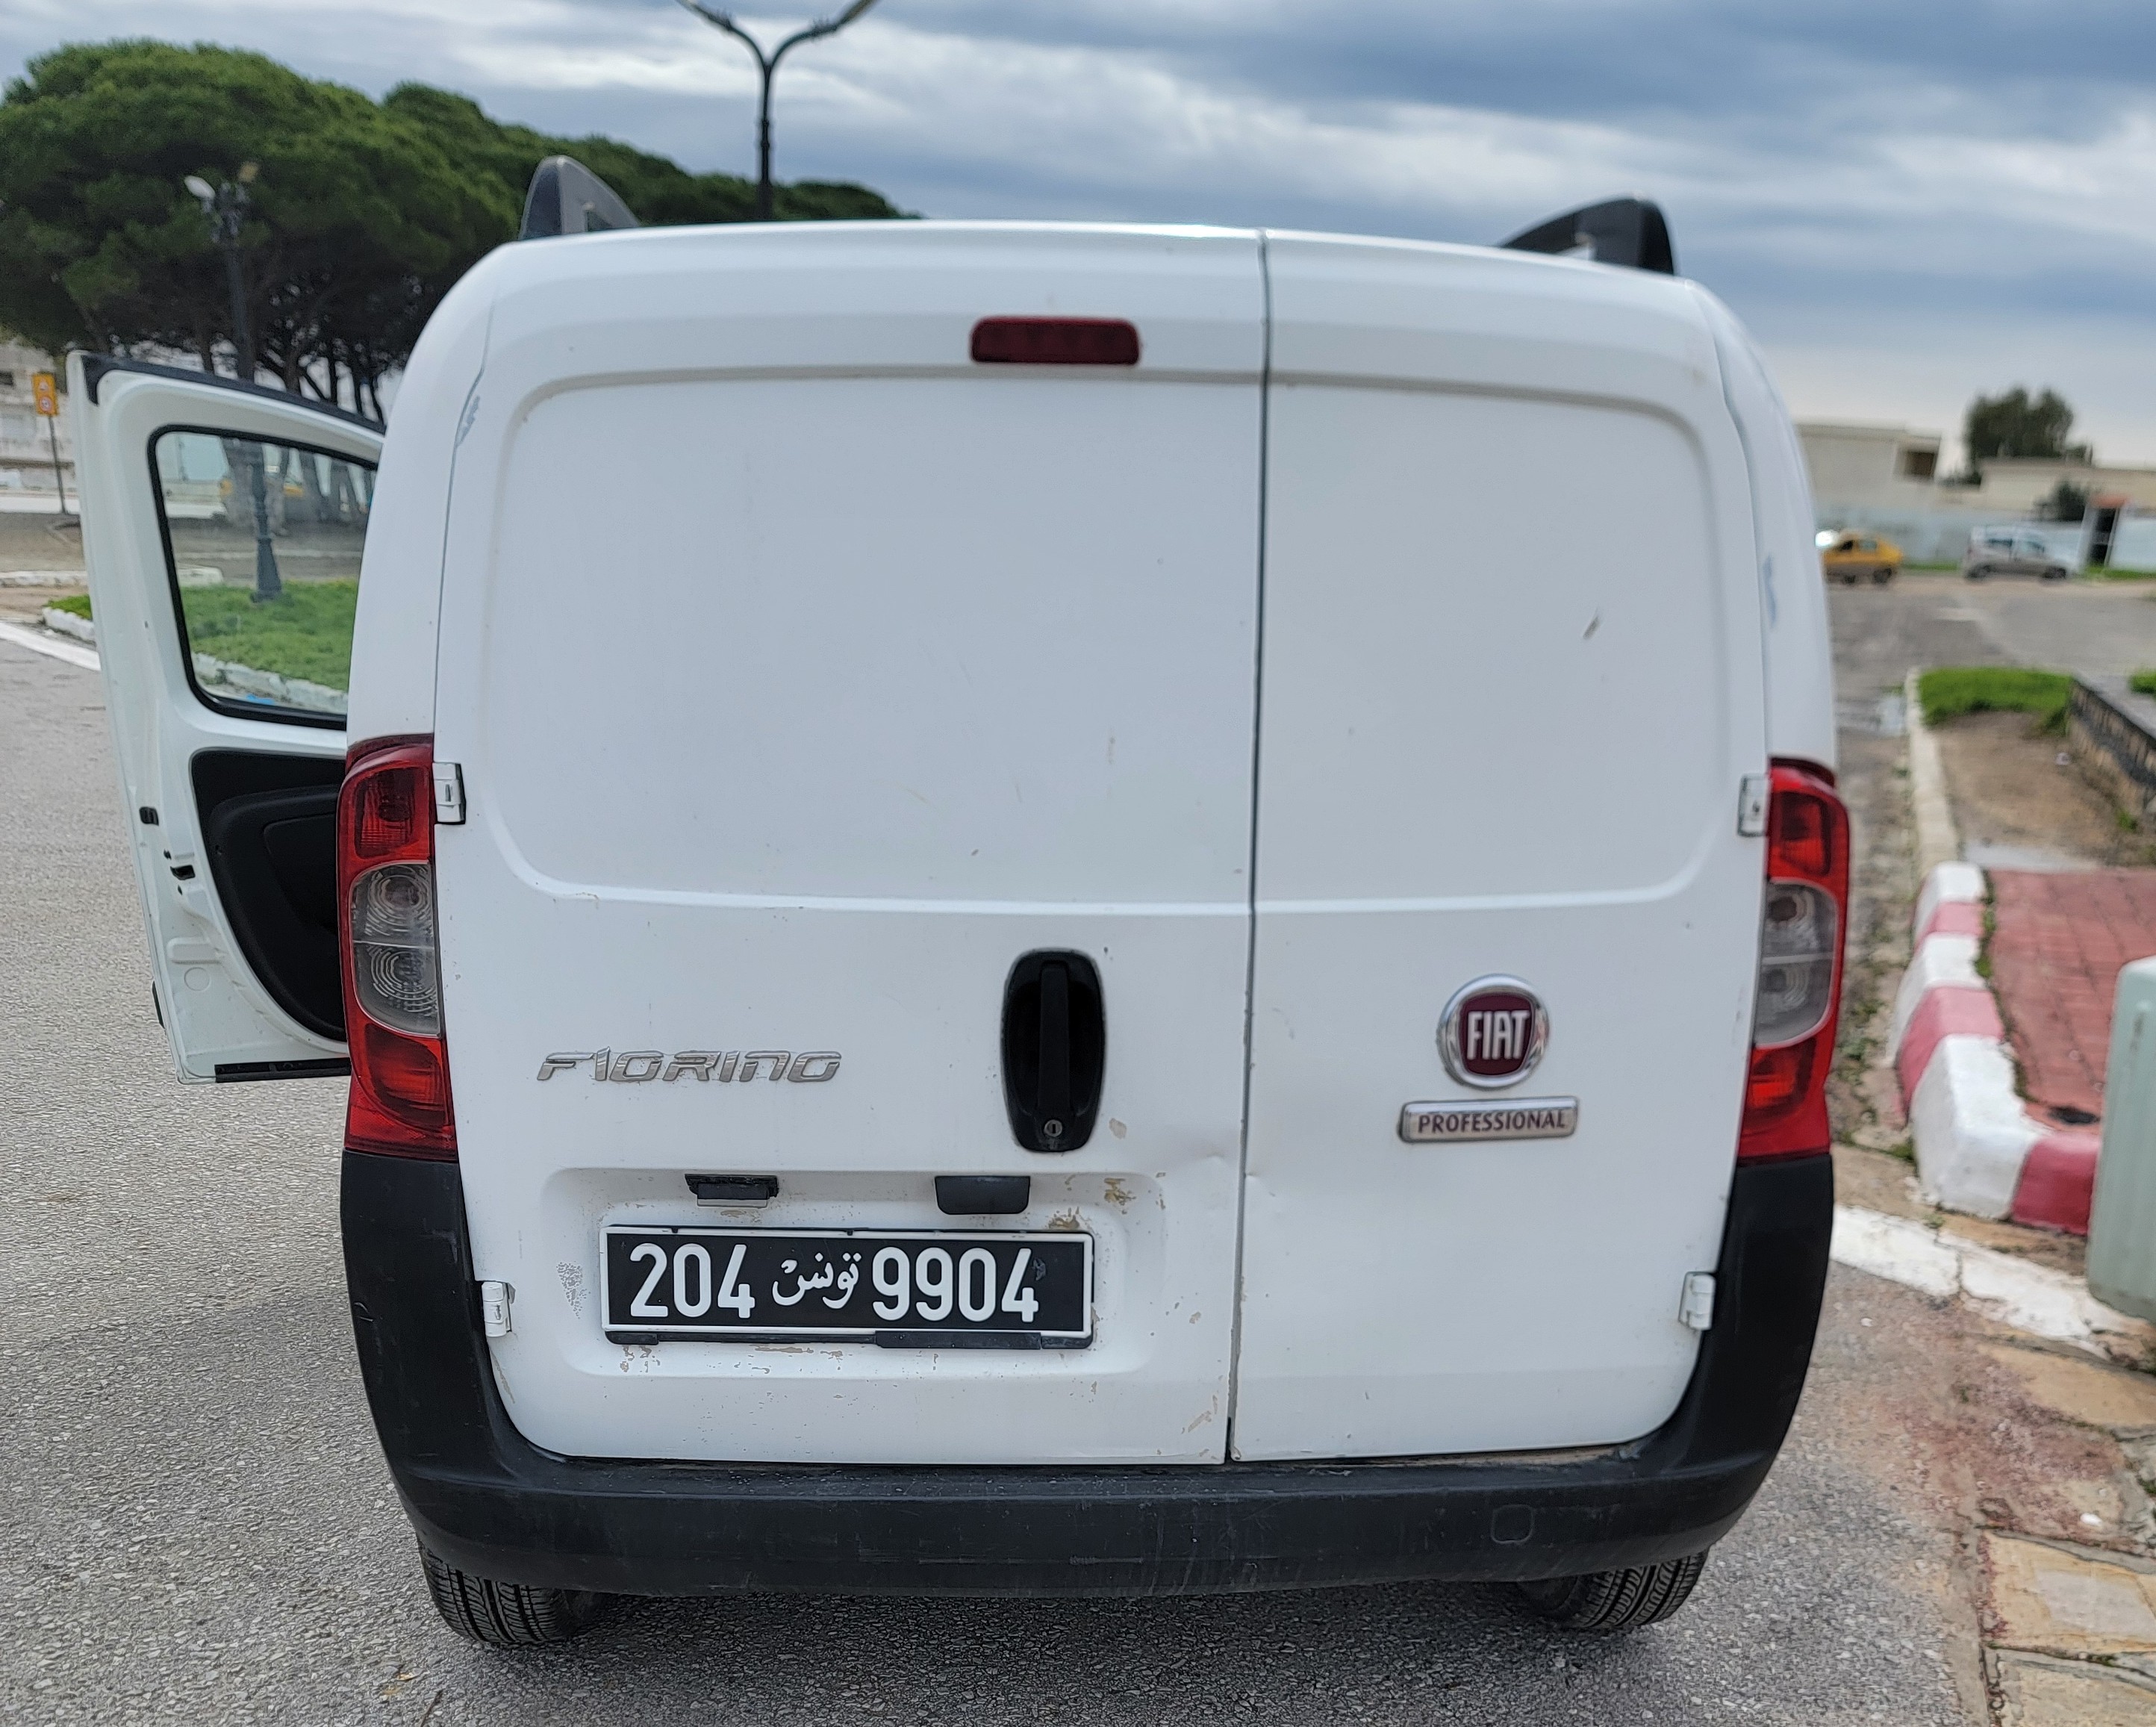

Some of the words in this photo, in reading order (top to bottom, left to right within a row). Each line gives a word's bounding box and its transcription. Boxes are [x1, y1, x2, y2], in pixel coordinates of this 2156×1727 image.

[1467, 1009, 1530, 1060] FIAT
[537, 1046, 842, 1083] FIORINO
[1418, 1110, 1566, 1134] PROFESSIONAL
[629, 1243, 755, 1319] 204
[772, 1252, 862, 1310] تونس
[872, 1247, 1040, 1323] 9904
